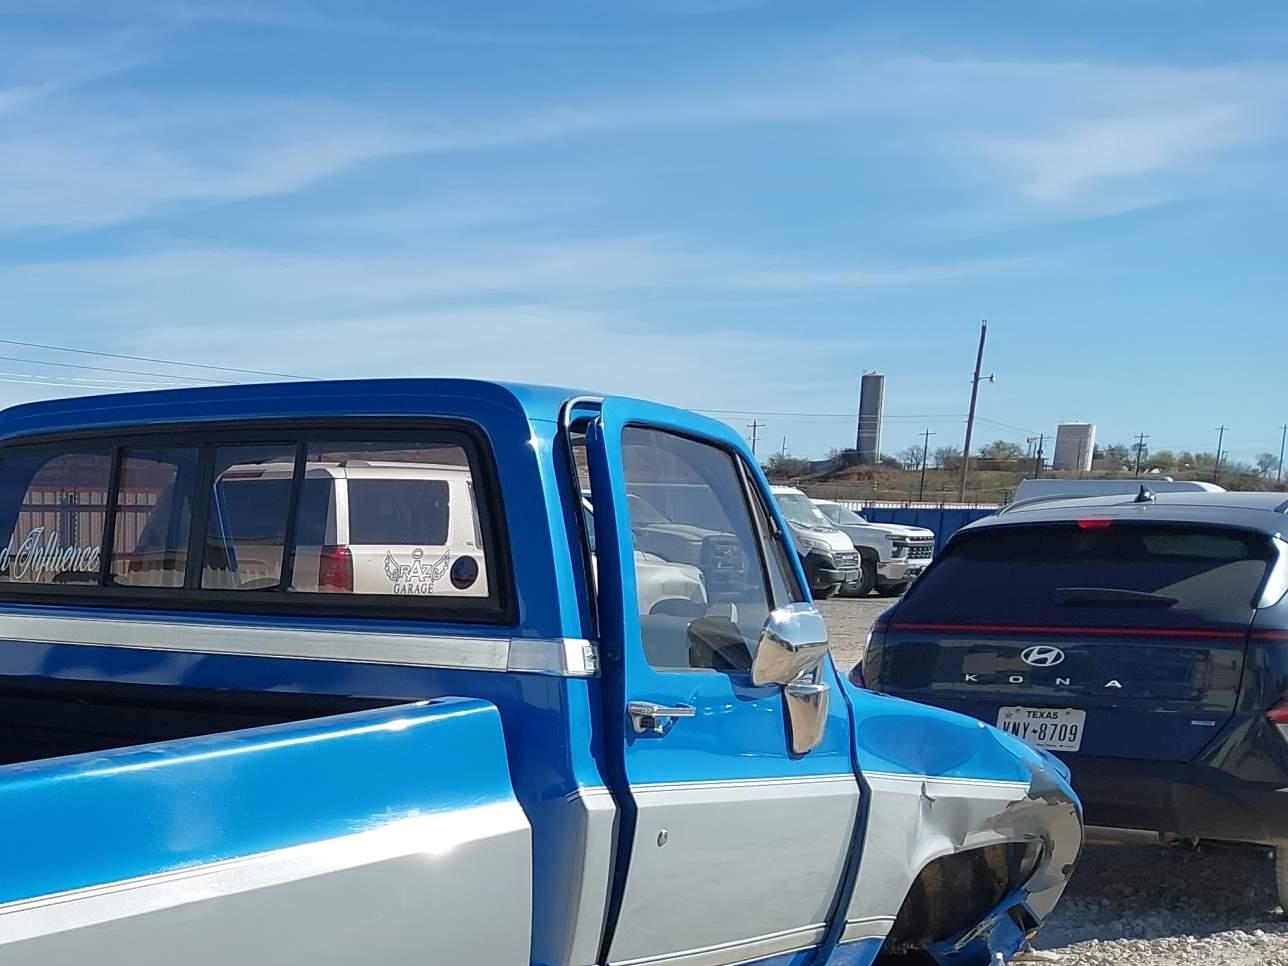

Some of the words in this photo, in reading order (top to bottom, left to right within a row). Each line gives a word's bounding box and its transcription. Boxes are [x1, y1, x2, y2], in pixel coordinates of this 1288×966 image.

[14, 526, 100, 583] Influence
[393, 583, 435, 595] GARAGE
[965, 673, 1123, 689] KONA
[1026, 710, 1059, 720] TEXAS
